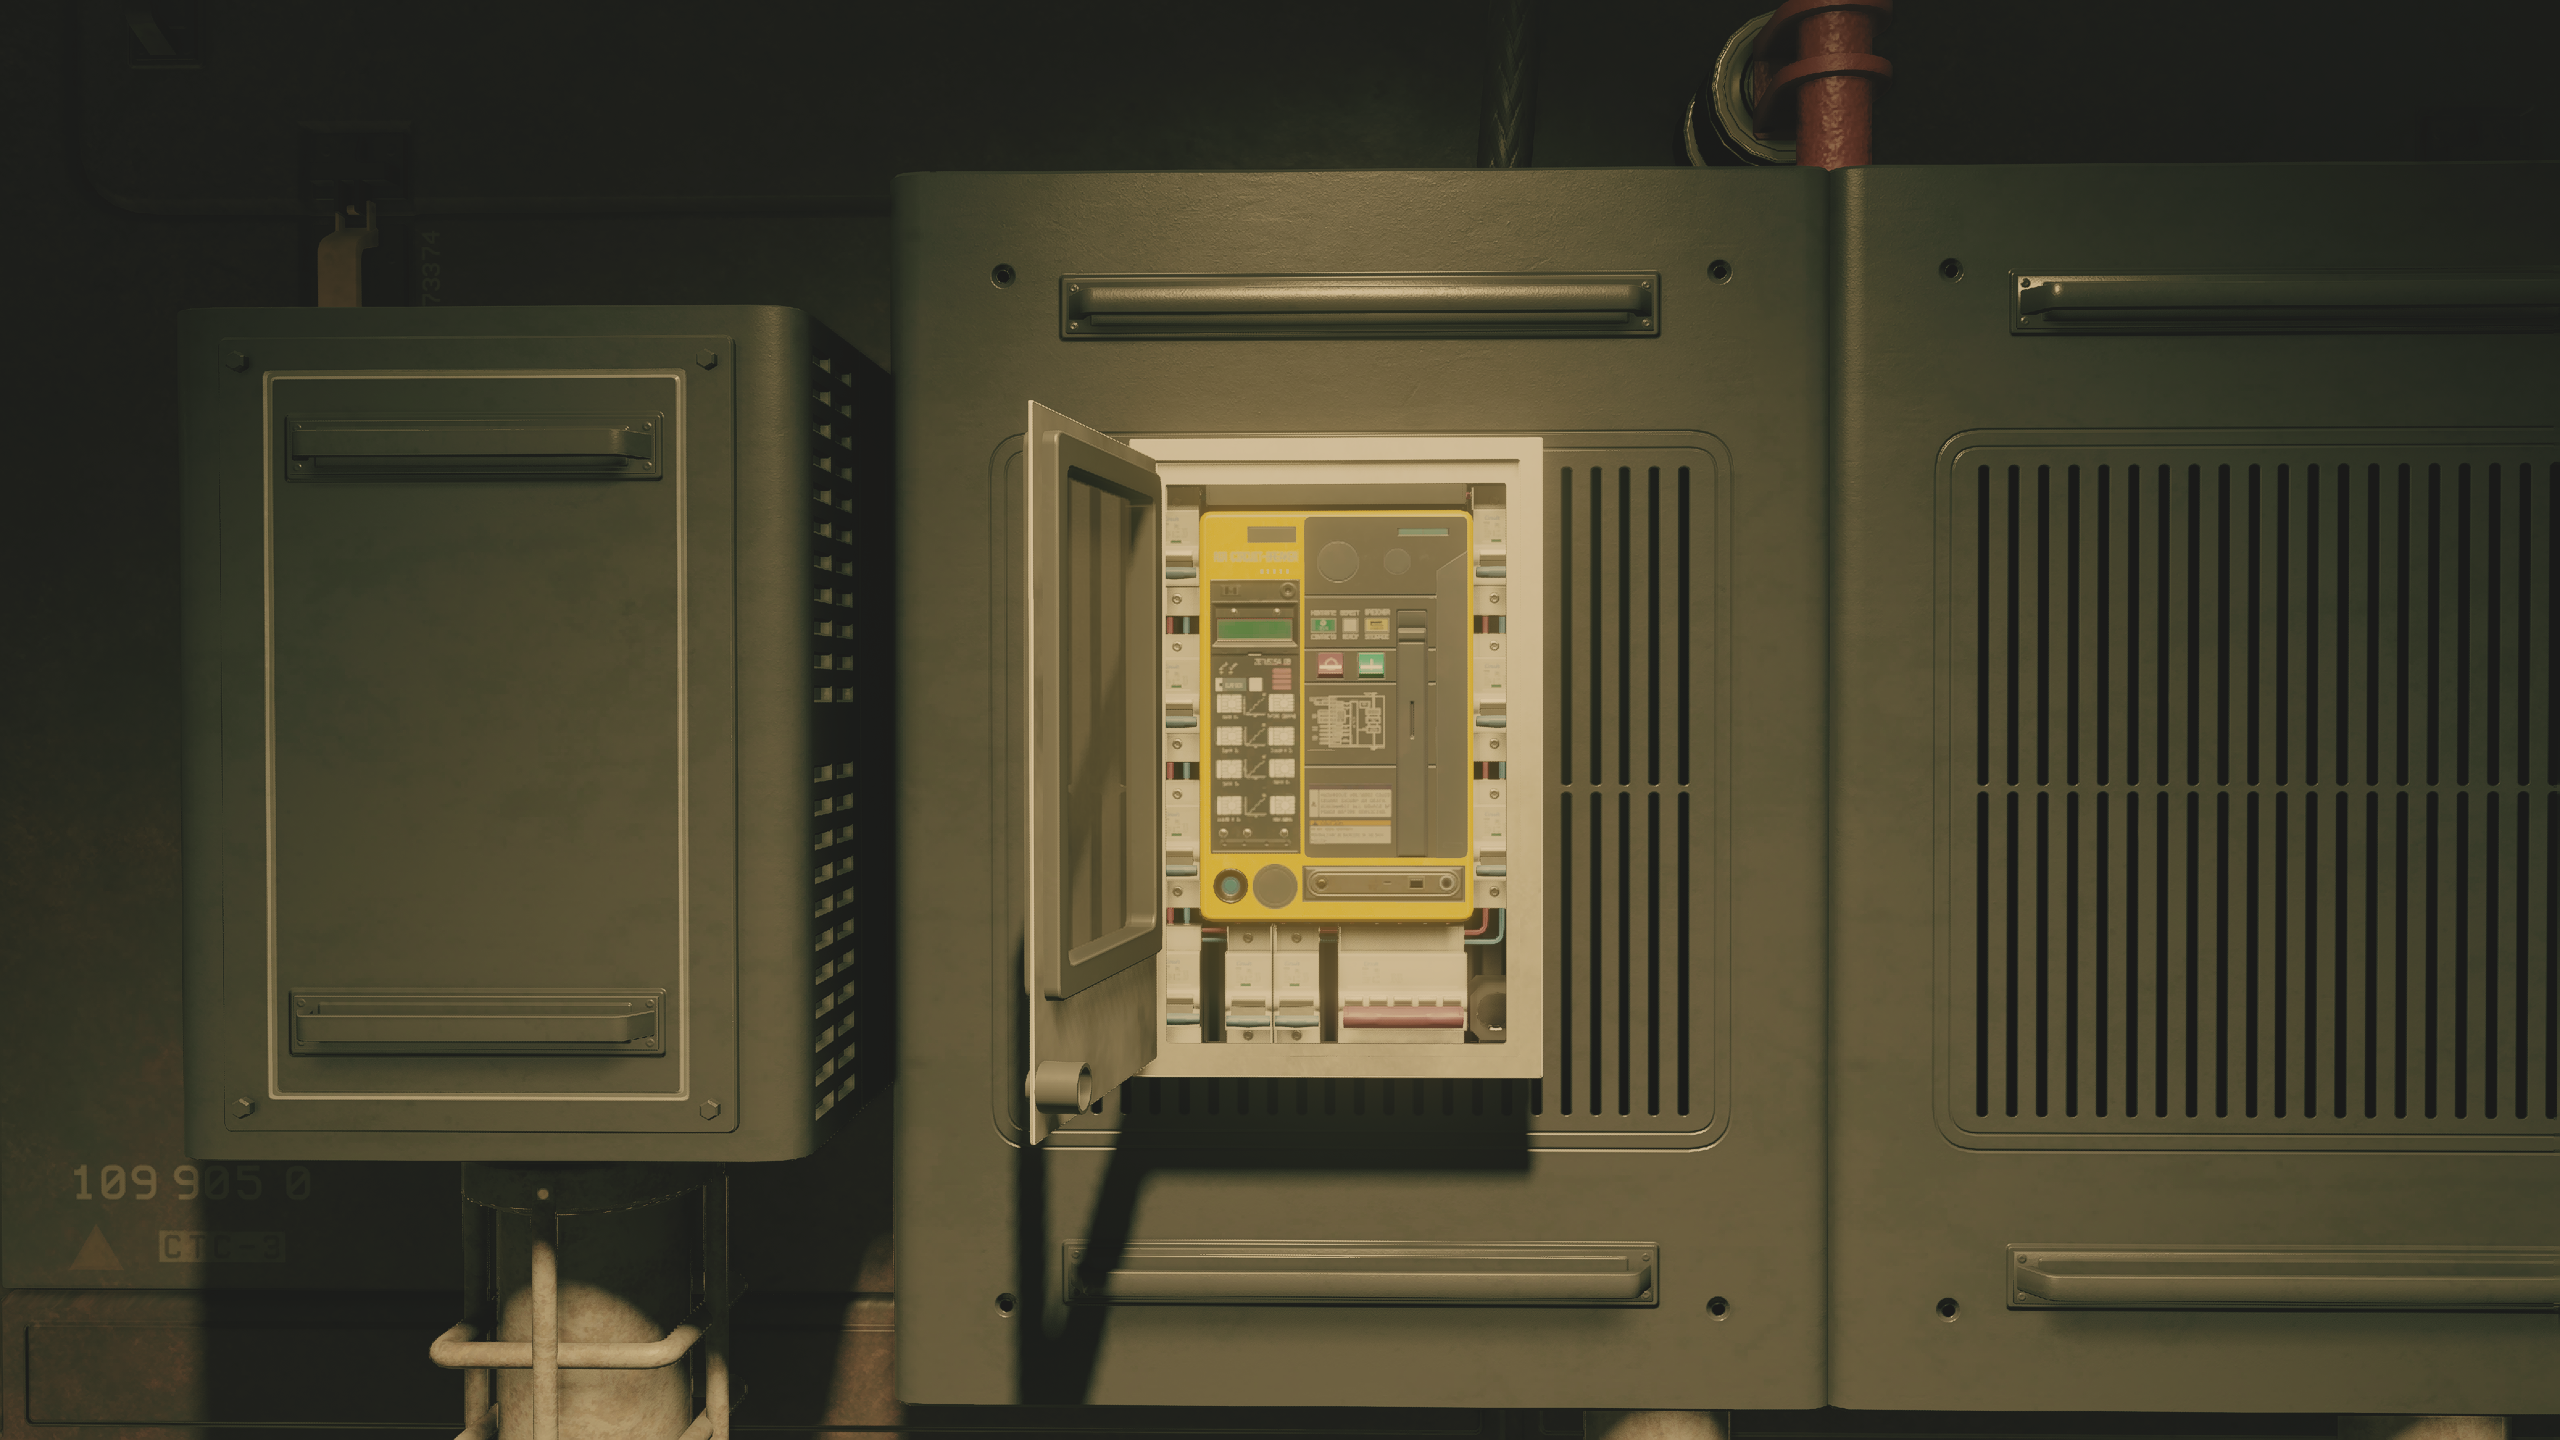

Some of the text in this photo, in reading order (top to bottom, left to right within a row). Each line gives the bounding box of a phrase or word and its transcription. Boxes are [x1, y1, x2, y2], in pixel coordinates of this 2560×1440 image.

[421, 230, 441, 306] 73374
[73, 1164, 311, 1201] 109 905 0
[163, 1234, 281, 1260] CTC-3
